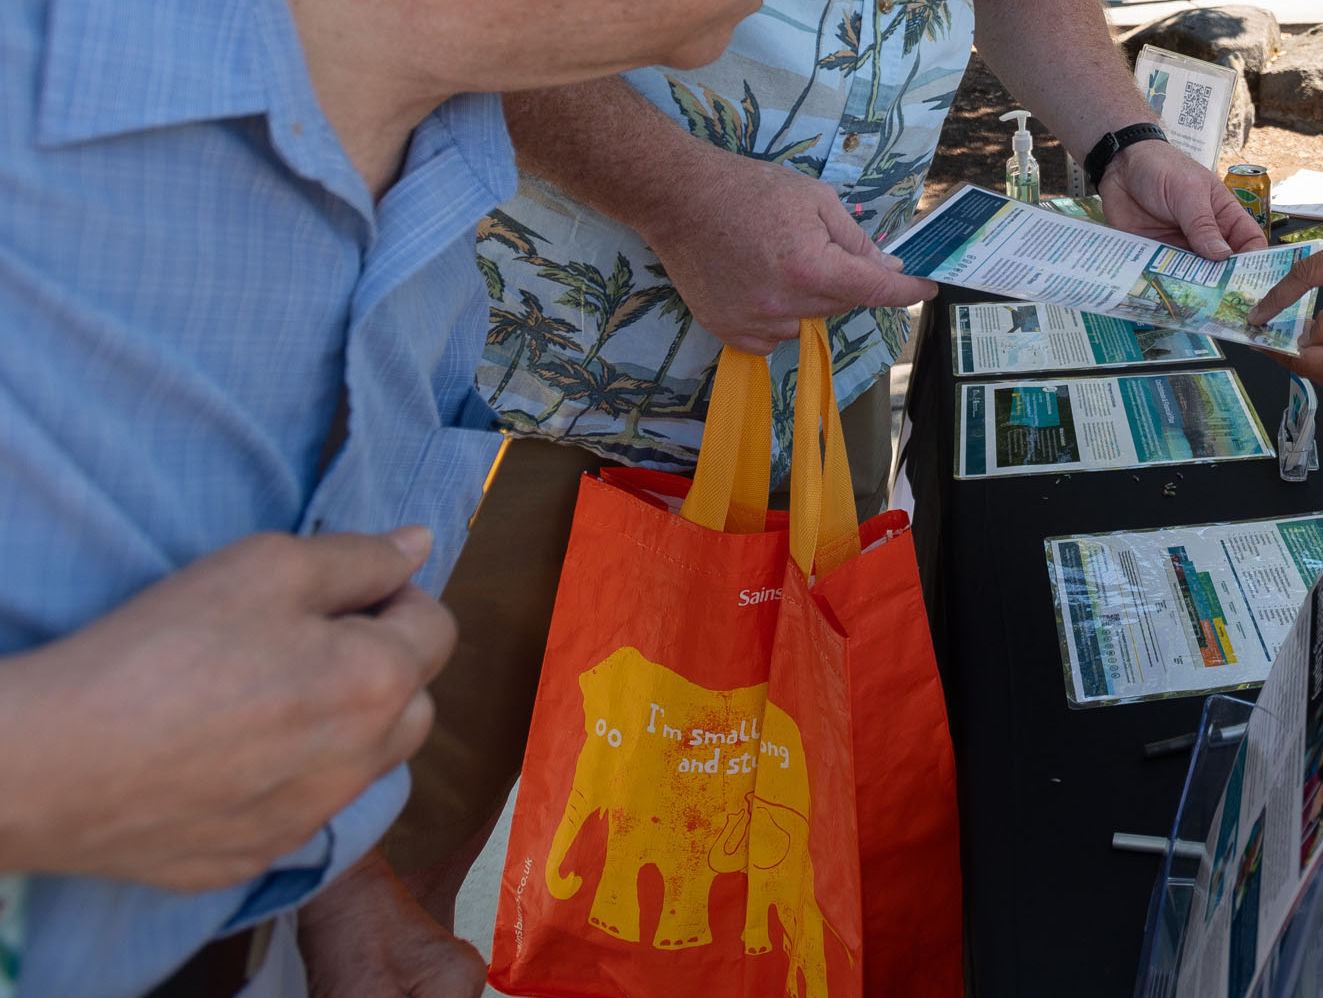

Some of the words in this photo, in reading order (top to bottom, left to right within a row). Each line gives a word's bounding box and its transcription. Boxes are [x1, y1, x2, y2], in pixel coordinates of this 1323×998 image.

[738, 587, 783, 607] Sains
[646, 703, 683, 741] I'm
[689, 718, 761, 746] small
[678, 747, 721, 774] and
